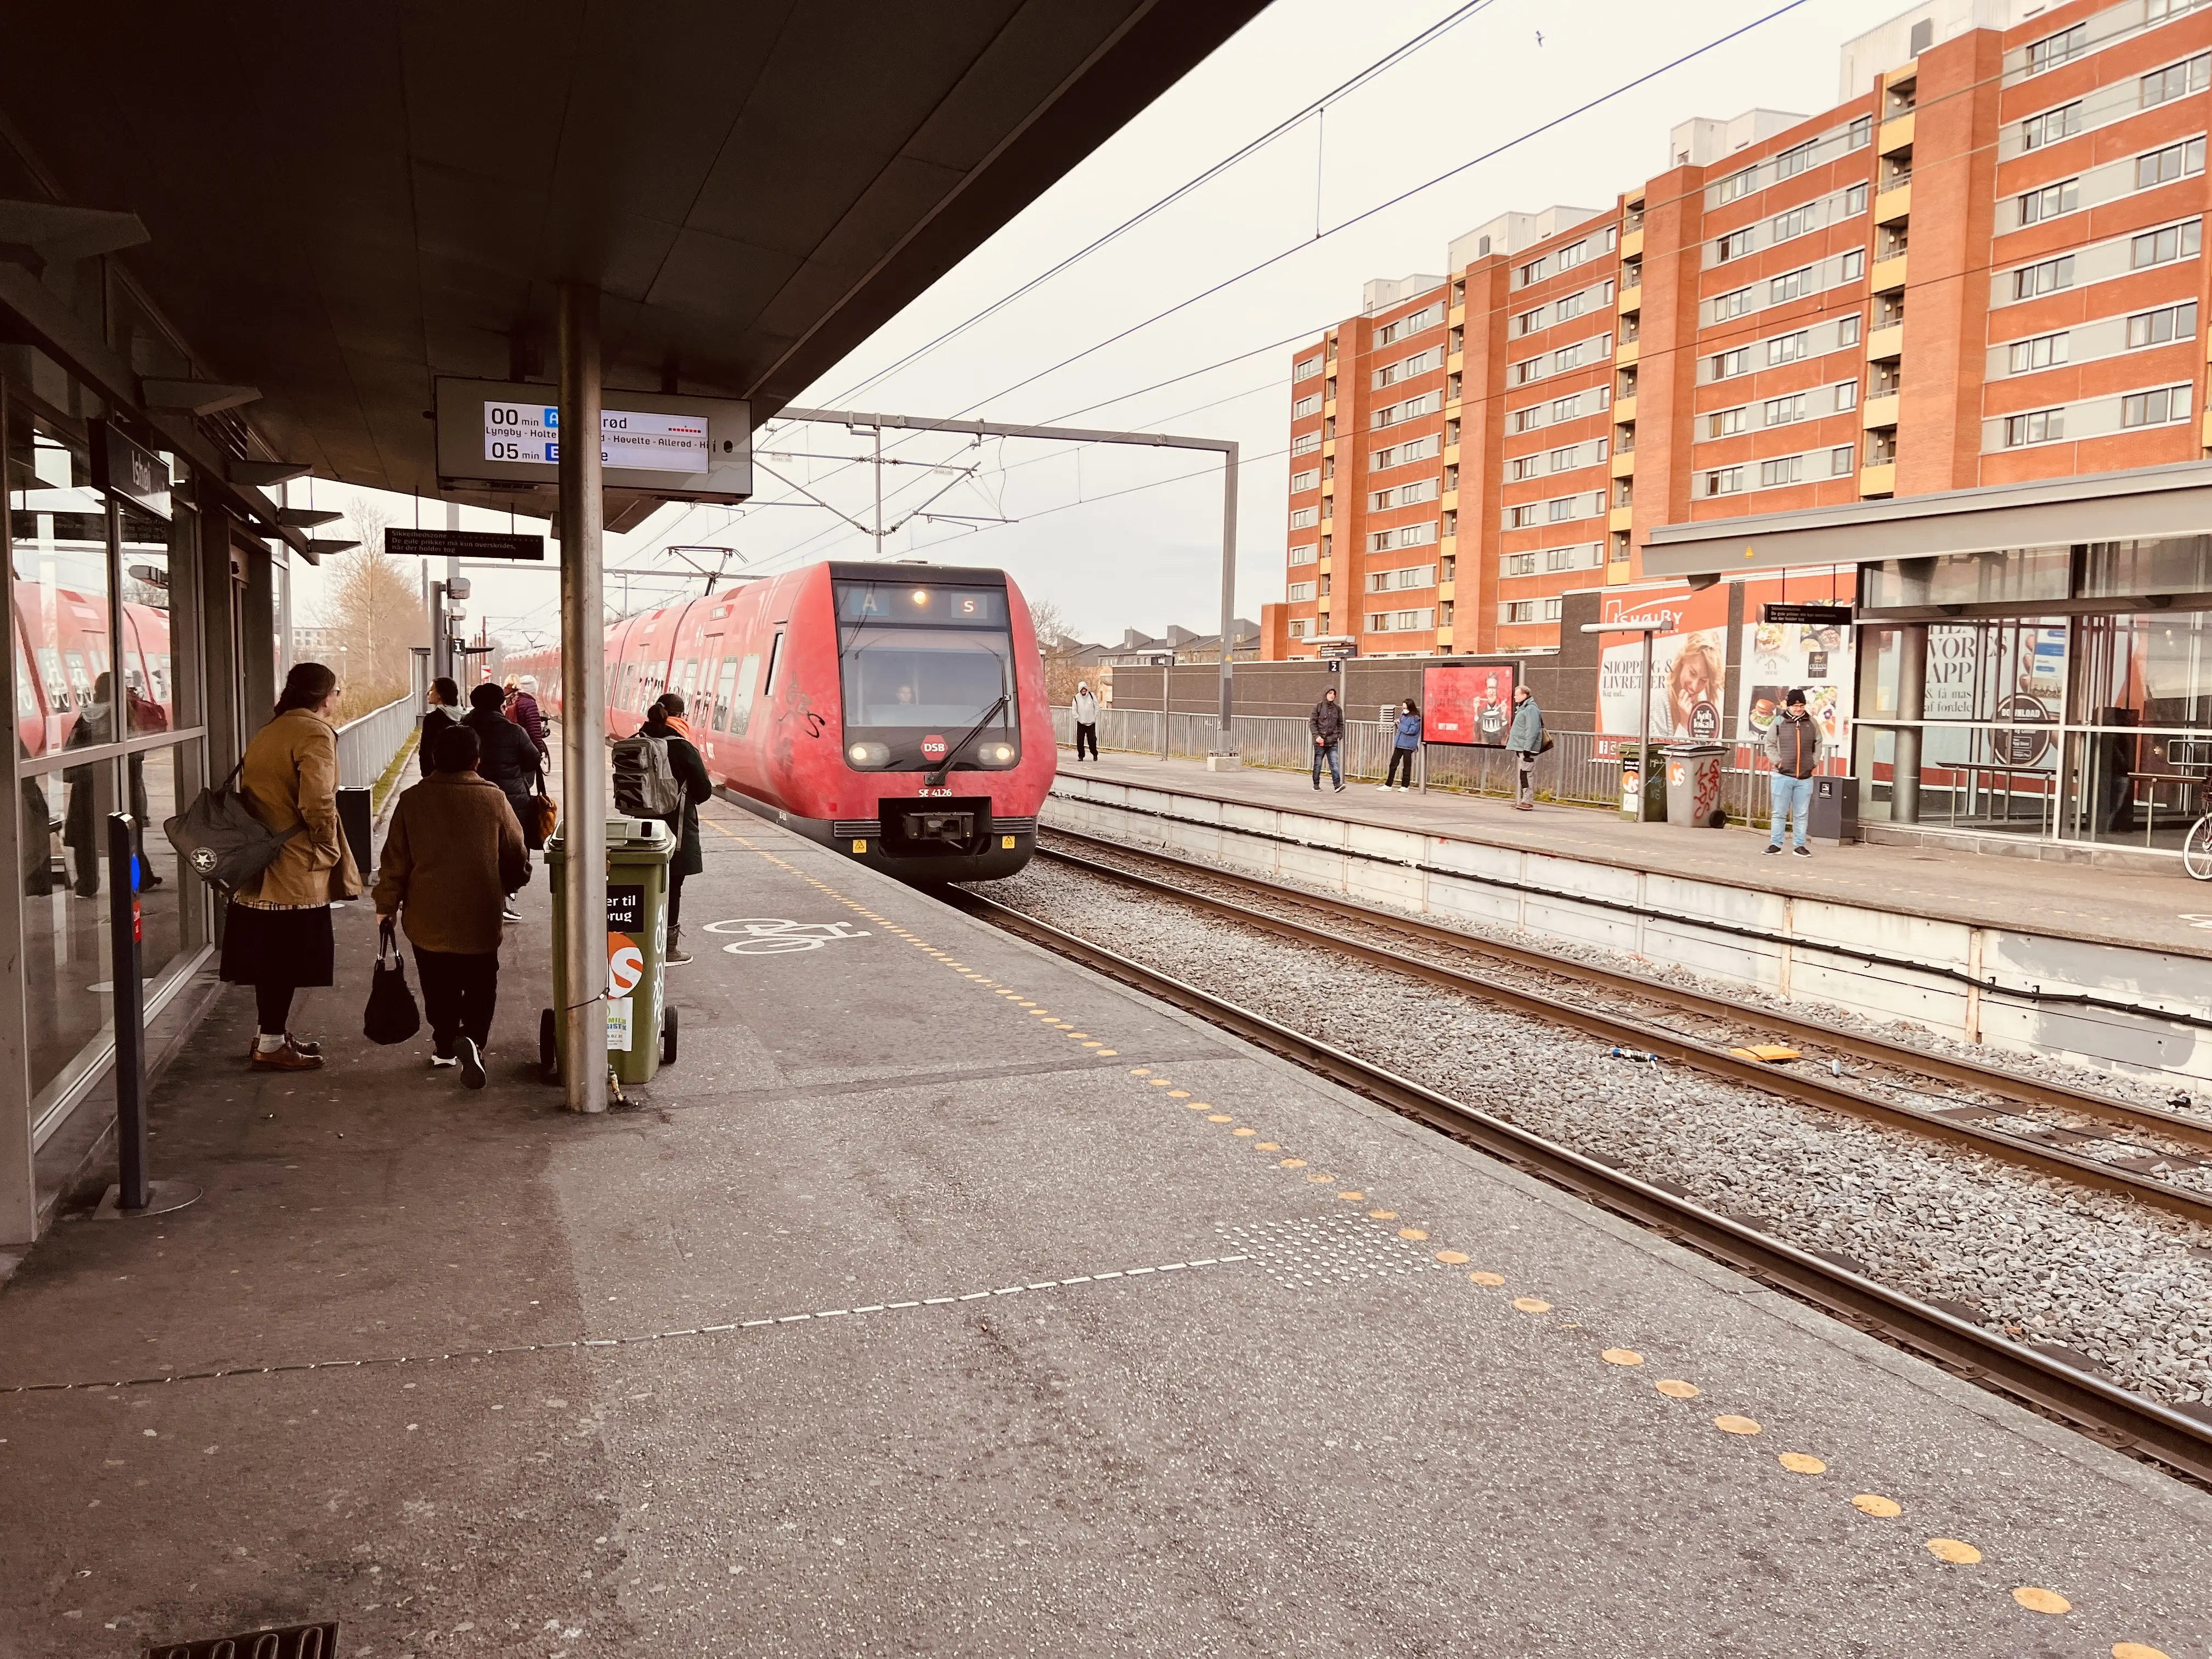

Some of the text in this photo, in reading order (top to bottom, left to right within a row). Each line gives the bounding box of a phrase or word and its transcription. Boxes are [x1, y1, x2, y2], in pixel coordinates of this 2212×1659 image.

[492, 408, 518, 425] 00
[486, 427, 521, 437] Lyngby
[531, 430, 557, 438] Holte
[659, 438, 691, 448] Allerød
[492, 442, 518, 459] 05
[392, 530, 447, 538] Sikkerhedszone
[862, 594, 878, 612] A
[963, 601, 974, 612] S
[455, 643, 461, 652] 1
[1603, 659, 1660, 674] SHOPPIG
[1926, 662, 1972, 683] APP
[1603, 675, 1666, 689] LIVRETER
[924, 743, 945, 752] DSB
[918, 789, 952, 797] SE 4126
[622, 895, 636, 906] til
